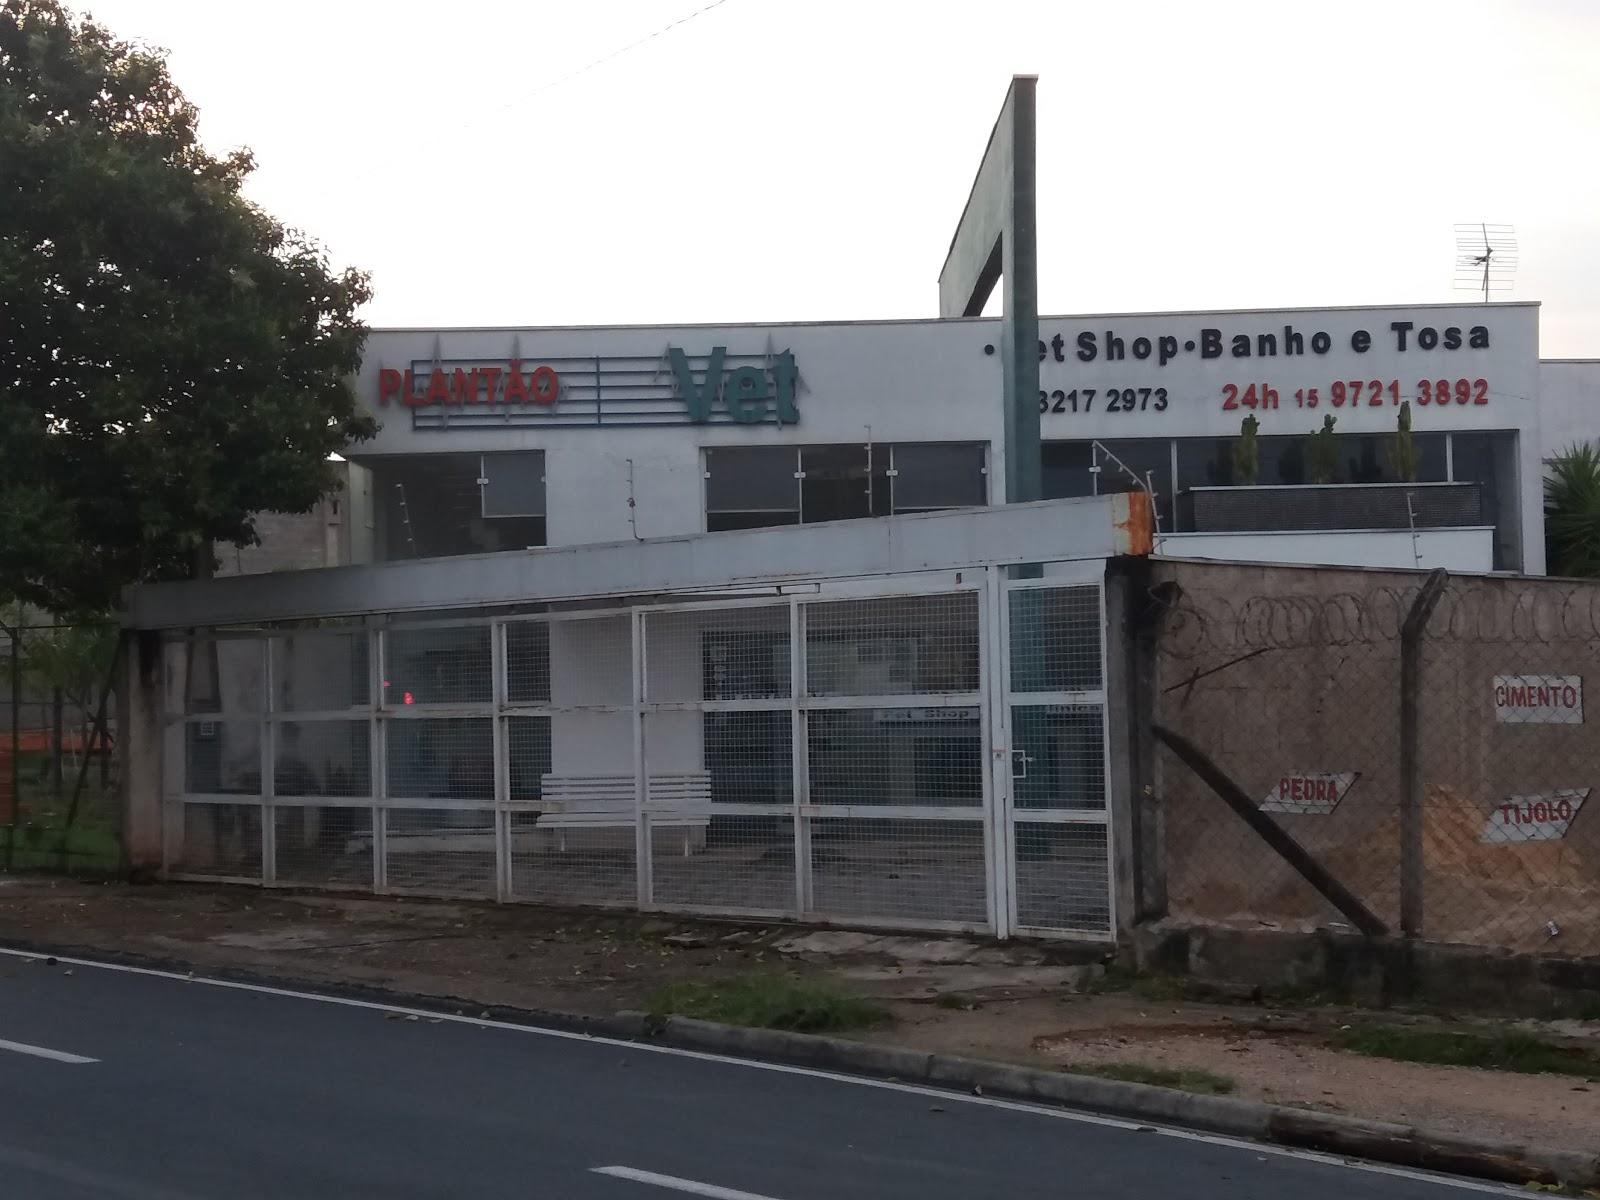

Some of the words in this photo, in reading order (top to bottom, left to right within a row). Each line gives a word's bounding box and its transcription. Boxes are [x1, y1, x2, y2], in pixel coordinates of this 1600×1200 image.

[1077, 330, 1178, 367] Shop
[1202, 324, 1332, 360] Banho
[1351, 330, 1372, 354] e
[1391, 321, 1490, 351] Tosa
[379, 359, 560, 407] PLANTÃO
[669, 346, 801, 424] Vet
[1222, 383, 1279, 411] 24h
[1296, 389, 1319, 408] 15
[1332, 379, 1400, 407] 9721
[1417, 378, 1489, 406] 3892
[1106, 387, 1169, 413] 2973
[1495, 685, 1576, 708] CIMENTO
[1279, 778, 1338, 802] PEDRA
[1499, 800, 1571, 825] TIJOLO
